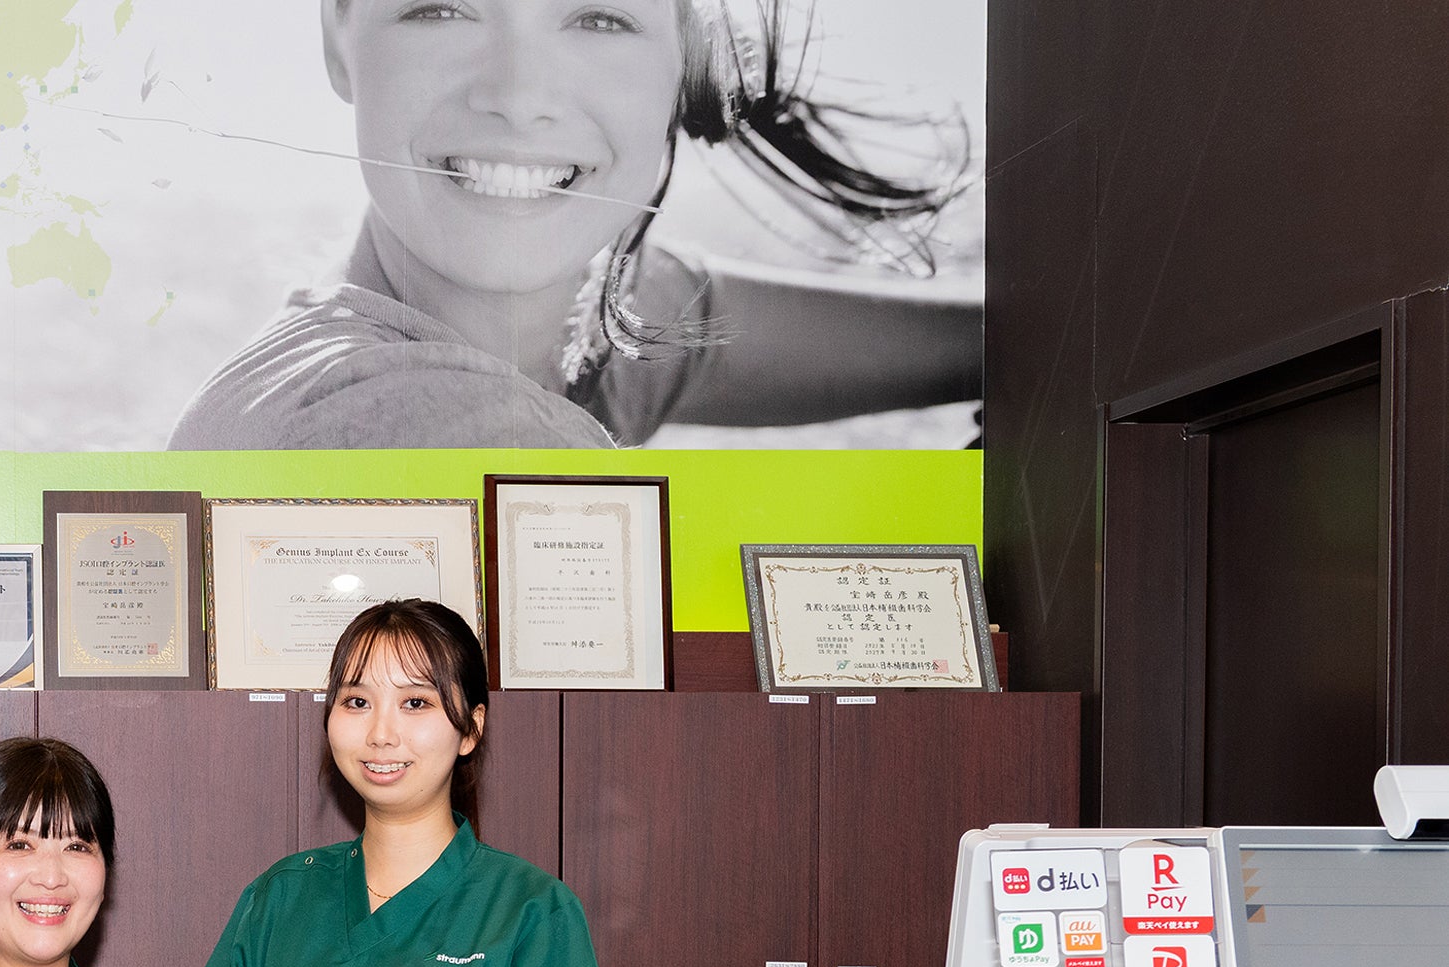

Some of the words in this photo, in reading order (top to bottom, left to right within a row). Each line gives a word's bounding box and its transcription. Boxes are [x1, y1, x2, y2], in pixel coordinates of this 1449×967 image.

[275, 548, 311, 557] Genius
[314, 548, 353, 557] Implant
[374, 548, 409, 557] Course
[836, 576, 892, 586] 認定証
[842, 614, 896, 623] 認定医
[826, 623, 913, 632] として認定します
[1153, 854, 1179, 885] R
[1004, 872, 1028, 883] d払い
[1037, 868, 1099, 892] d払い
[1148, 893, 1187, 912] Pay
[1069, 920, 1095, 931] au
[1138, 921, 1199, 930] 楽天ペイ使えます
[1071, 935, 1095, 946] PAY
[1009, 956, 1049, 964] ゆうちょPay
